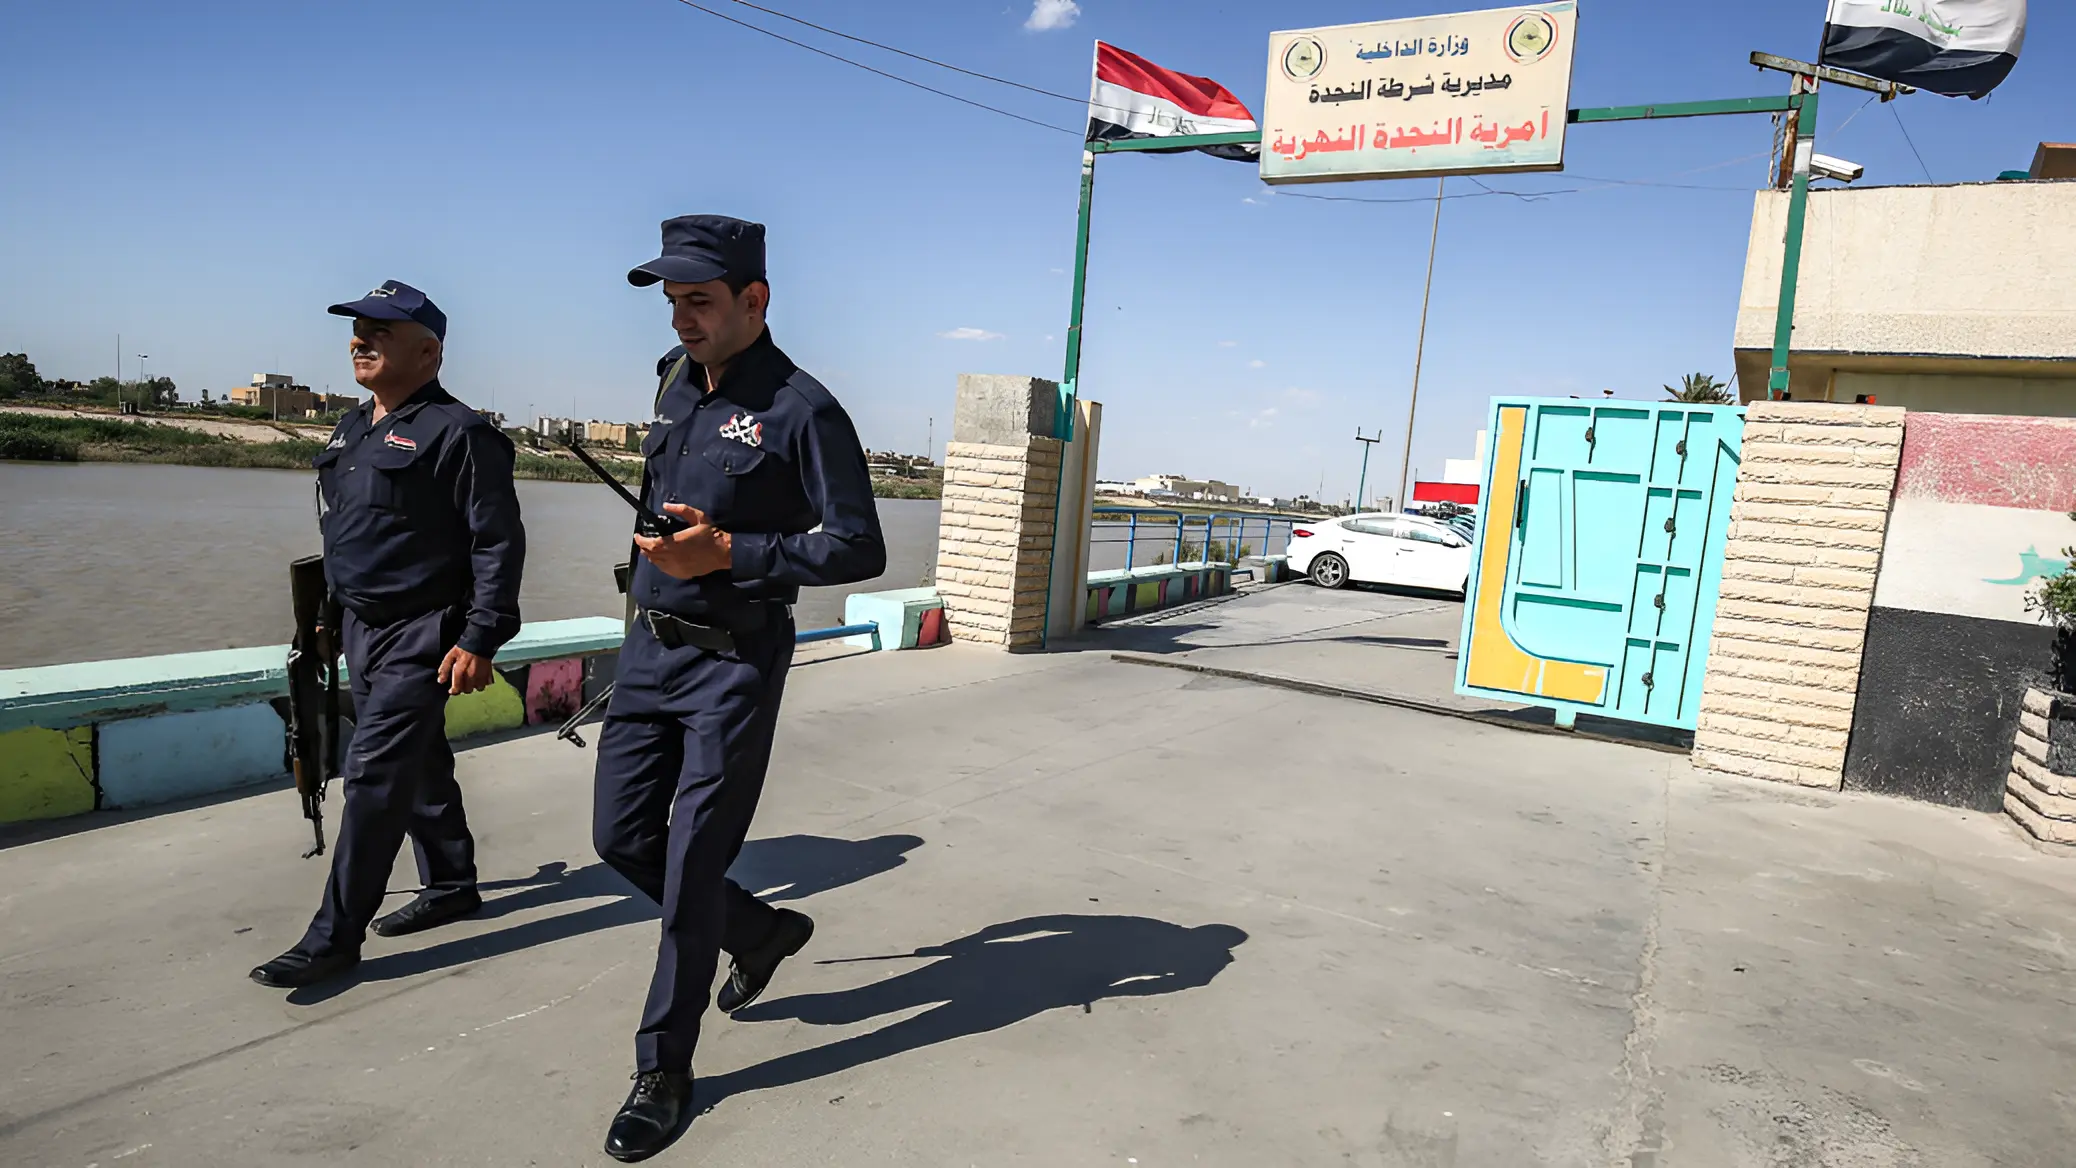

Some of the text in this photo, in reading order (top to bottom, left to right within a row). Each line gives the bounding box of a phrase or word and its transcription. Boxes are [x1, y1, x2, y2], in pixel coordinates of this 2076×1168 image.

[1356, 34, 1469, 64] وزارة الداخلية
[1309, 72, 1512, 106] مديرية شرطة النجدة
[1272, 124, 1365, 161] النهرية
[1373, 116, 1462, 153] النجدة
